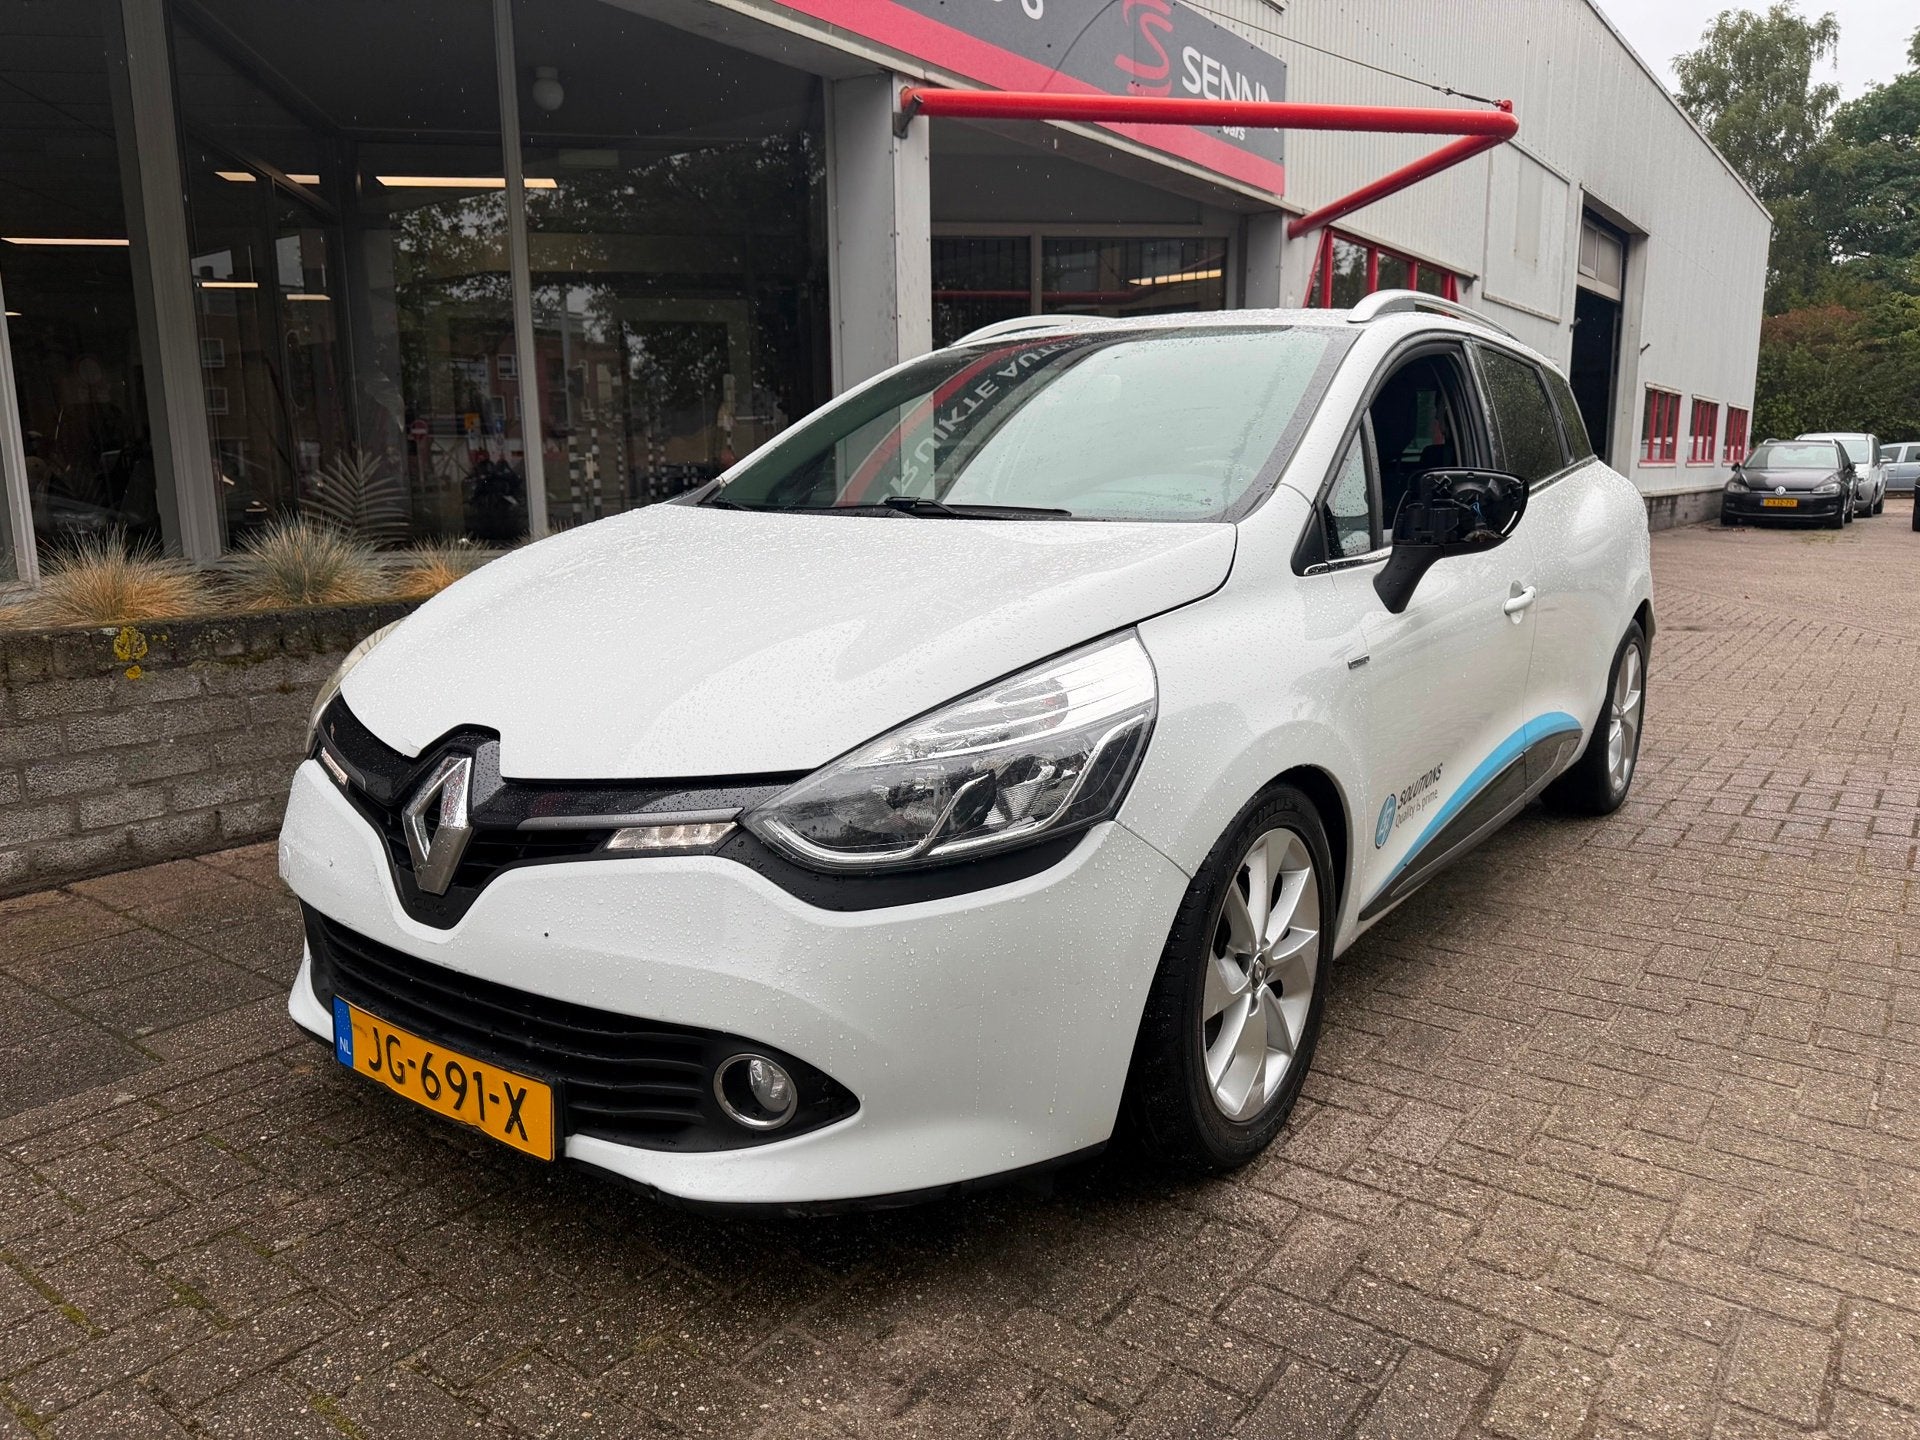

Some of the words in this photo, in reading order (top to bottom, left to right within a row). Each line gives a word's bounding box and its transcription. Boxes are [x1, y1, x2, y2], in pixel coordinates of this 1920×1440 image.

[1397, 764, 1443, 810] SOLUTIONS
[339, 1036, 352, 1056] NL
[368, 1026, 529, 1142] JG-691-X
